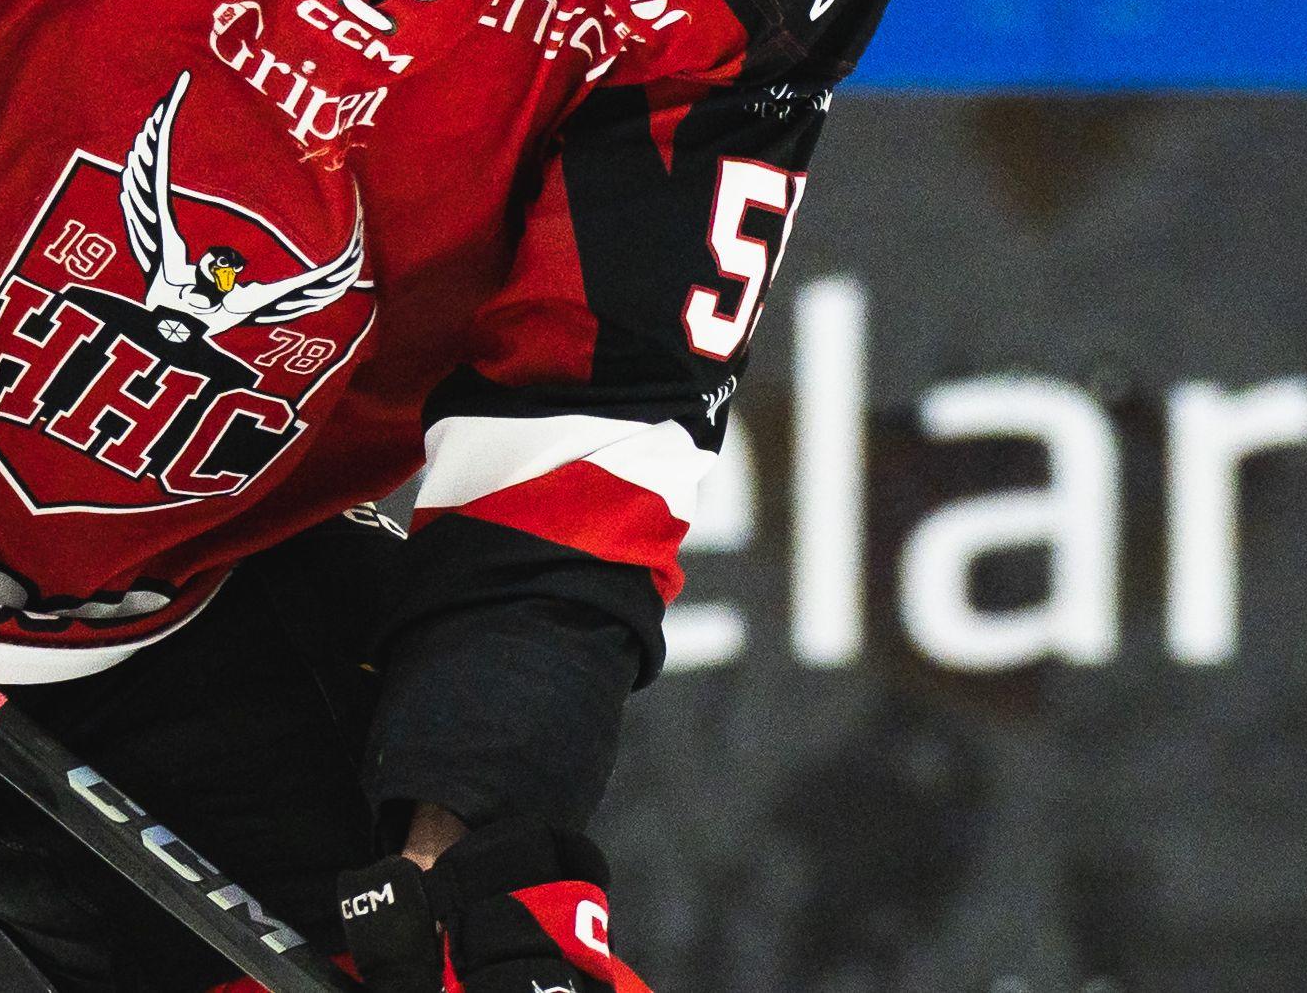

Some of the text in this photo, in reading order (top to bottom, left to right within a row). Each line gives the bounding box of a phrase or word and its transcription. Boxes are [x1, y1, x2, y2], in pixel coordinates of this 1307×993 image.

[43, 218, 118, 281] 19
[253, 327, 337, 375] 78
[66, 764, 307, 955] CCM
[341, 882, 395, 920] CCM
